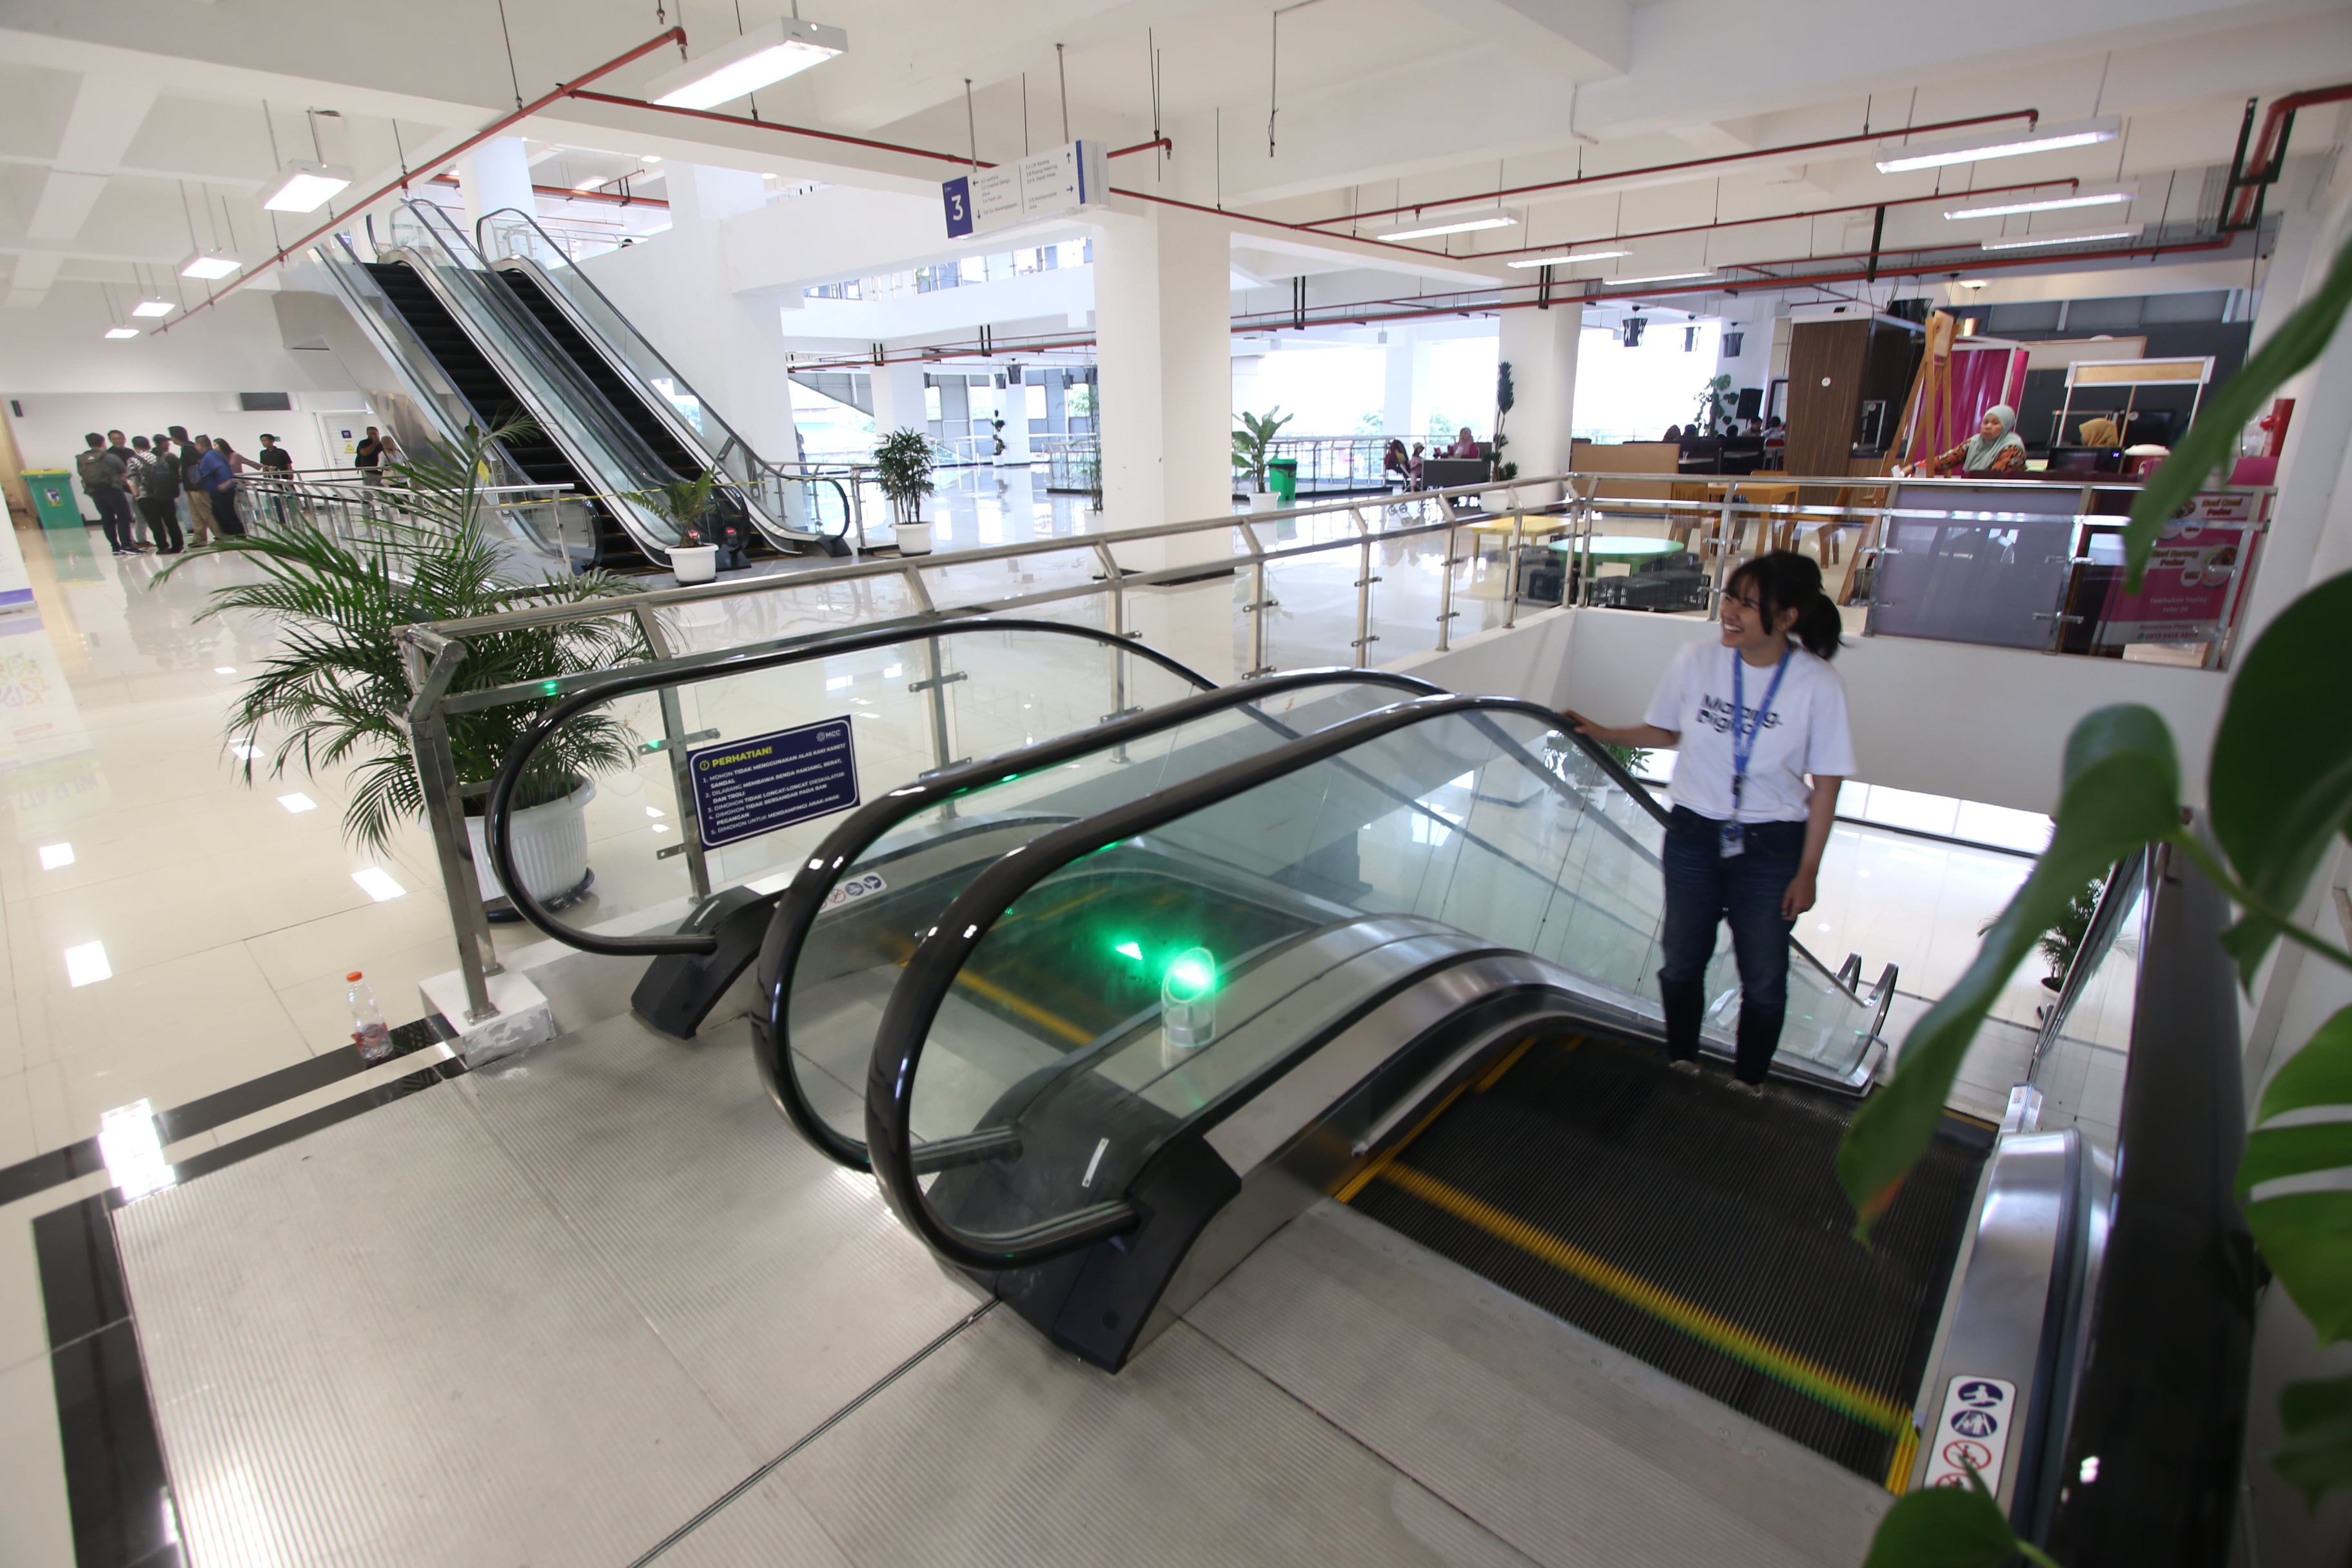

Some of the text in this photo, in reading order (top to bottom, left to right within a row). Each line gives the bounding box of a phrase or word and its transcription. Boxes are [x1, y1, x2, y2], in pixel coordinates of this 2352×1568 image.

[951, 194, 963, 220] 3
[825, 729, 841, 738] MCC
[709, 771, 733, 781] MOHON
[734, 766, 752, 776] TIDAK
[752, 754, 798, 771] MENGGUNAKAN
[712, 746, 772, 767] PERHATIAN!
[710, 778, 736, 789] SANDAL
[712, 784, 742, 796] DILARANG
[743, 776, 775, 788] MEMBAWA
[775, 771, 796, 780] BENDA
[796, 763, 823, 774] PANJANG,
[714, 799, 744, 811] DIMOHON
[745, 794, 762, 803] TIDAK
[763, 781, 808, 798] LONCAT-LONCAT
[808, 772, 845, 786] DIESKALATOR
[713, 791, 746, 804] DAN TROLI
[715, 806, 745, 818] DIMOHON
[745, 801, 763, 810] TIDAK
[764, 792, 798, 805] BERSANDAR
[799, 787, 814, 796] PADA
[716, 812, 750, 825] PEGANGAN
[717, 821, 747, 833] DIMOHON
[747, 814, 767, 825] UNTUK
[768, 804, 808, 819] MENDAMPINGI
[808, 794, 840, 807] ANAK-ANAK
